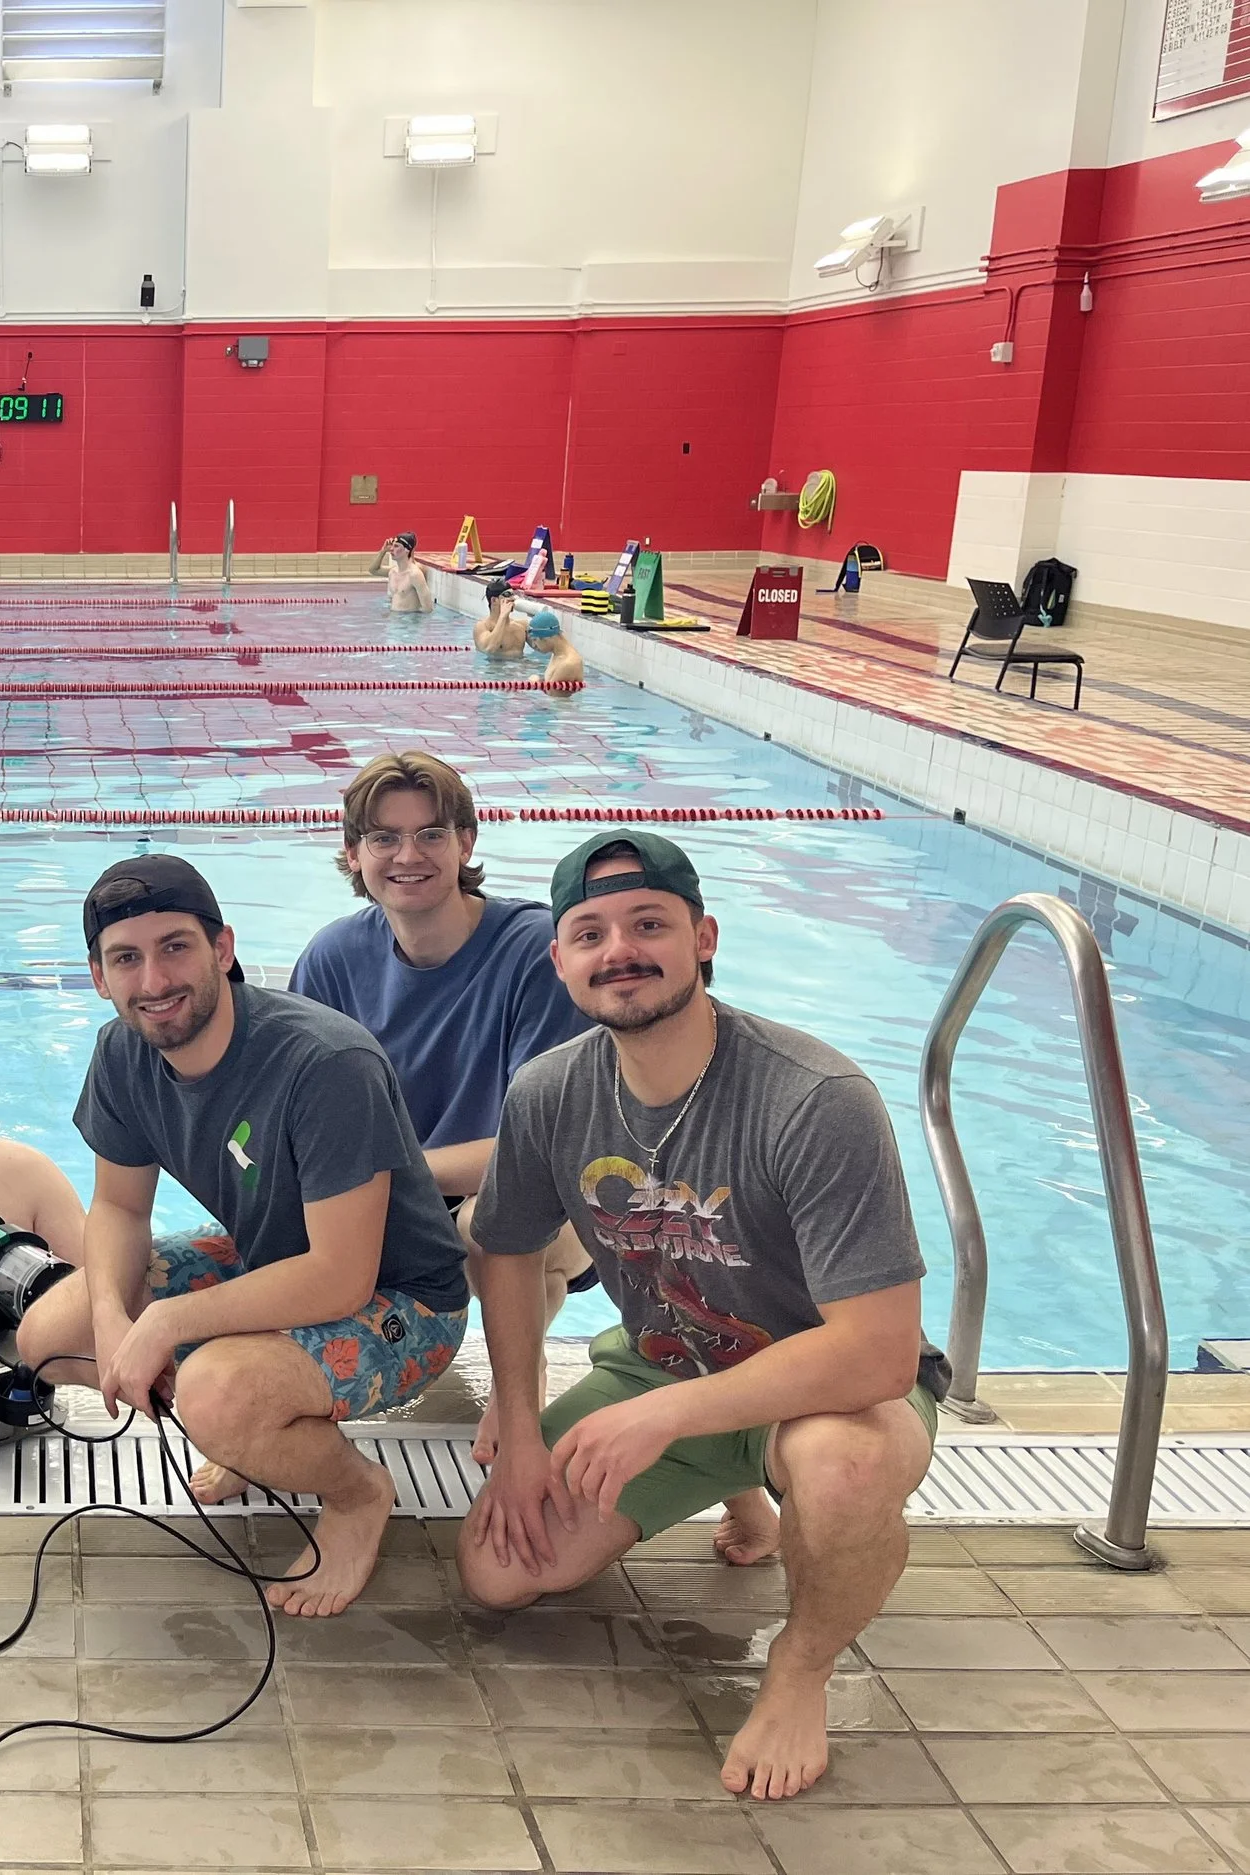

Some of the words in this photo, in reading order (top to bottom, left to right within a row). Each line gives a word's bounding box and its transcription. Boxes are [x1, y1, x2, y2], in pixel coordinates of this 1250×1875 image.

[0, 396, 28, 421] 09
[757, 588, 798, 603] CLOSED
[593, 1226, 751, 1267] OSBOURNE
